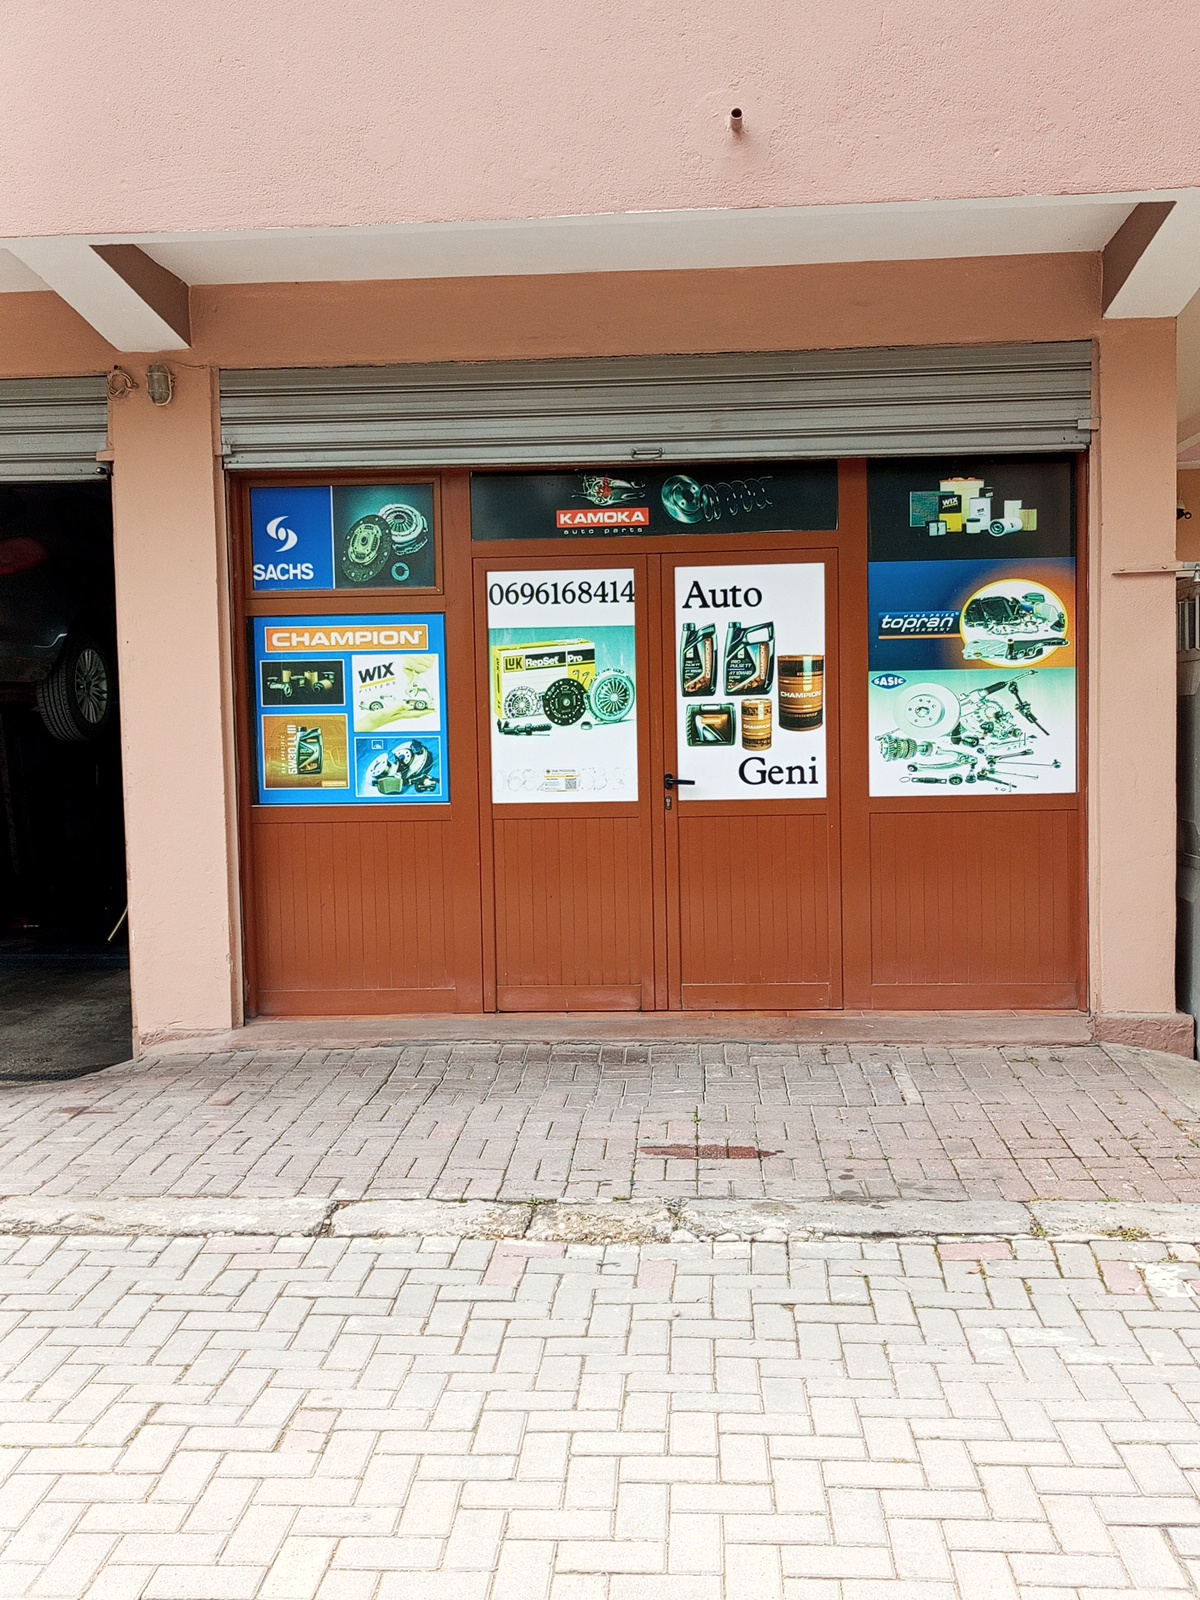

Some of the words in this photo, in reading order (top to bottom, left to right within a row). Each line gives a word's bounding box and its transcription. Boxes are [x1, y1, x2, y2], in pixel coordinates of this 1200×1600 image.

[560, 511, 645, 525] KAMOKA
[604, 527, 643, 535] parts
[253, 563, 314, 581] SACHS
[489, 580, 635, 606] 0696168414
[682, 580, 762, 609] Auto
[881, 614, 954, 633] topran
[271, 630, 420, 647] CHAMPION
[525, 655, 560, 668] RepSet
[567, 654, 583, 663] Pro
[358, 662, 396, 684] WIX
[780, 690, 822, 699] CHAMPION
[288, 747, 298, 775] 5W30
[738, 756, 819, 785] Geni
